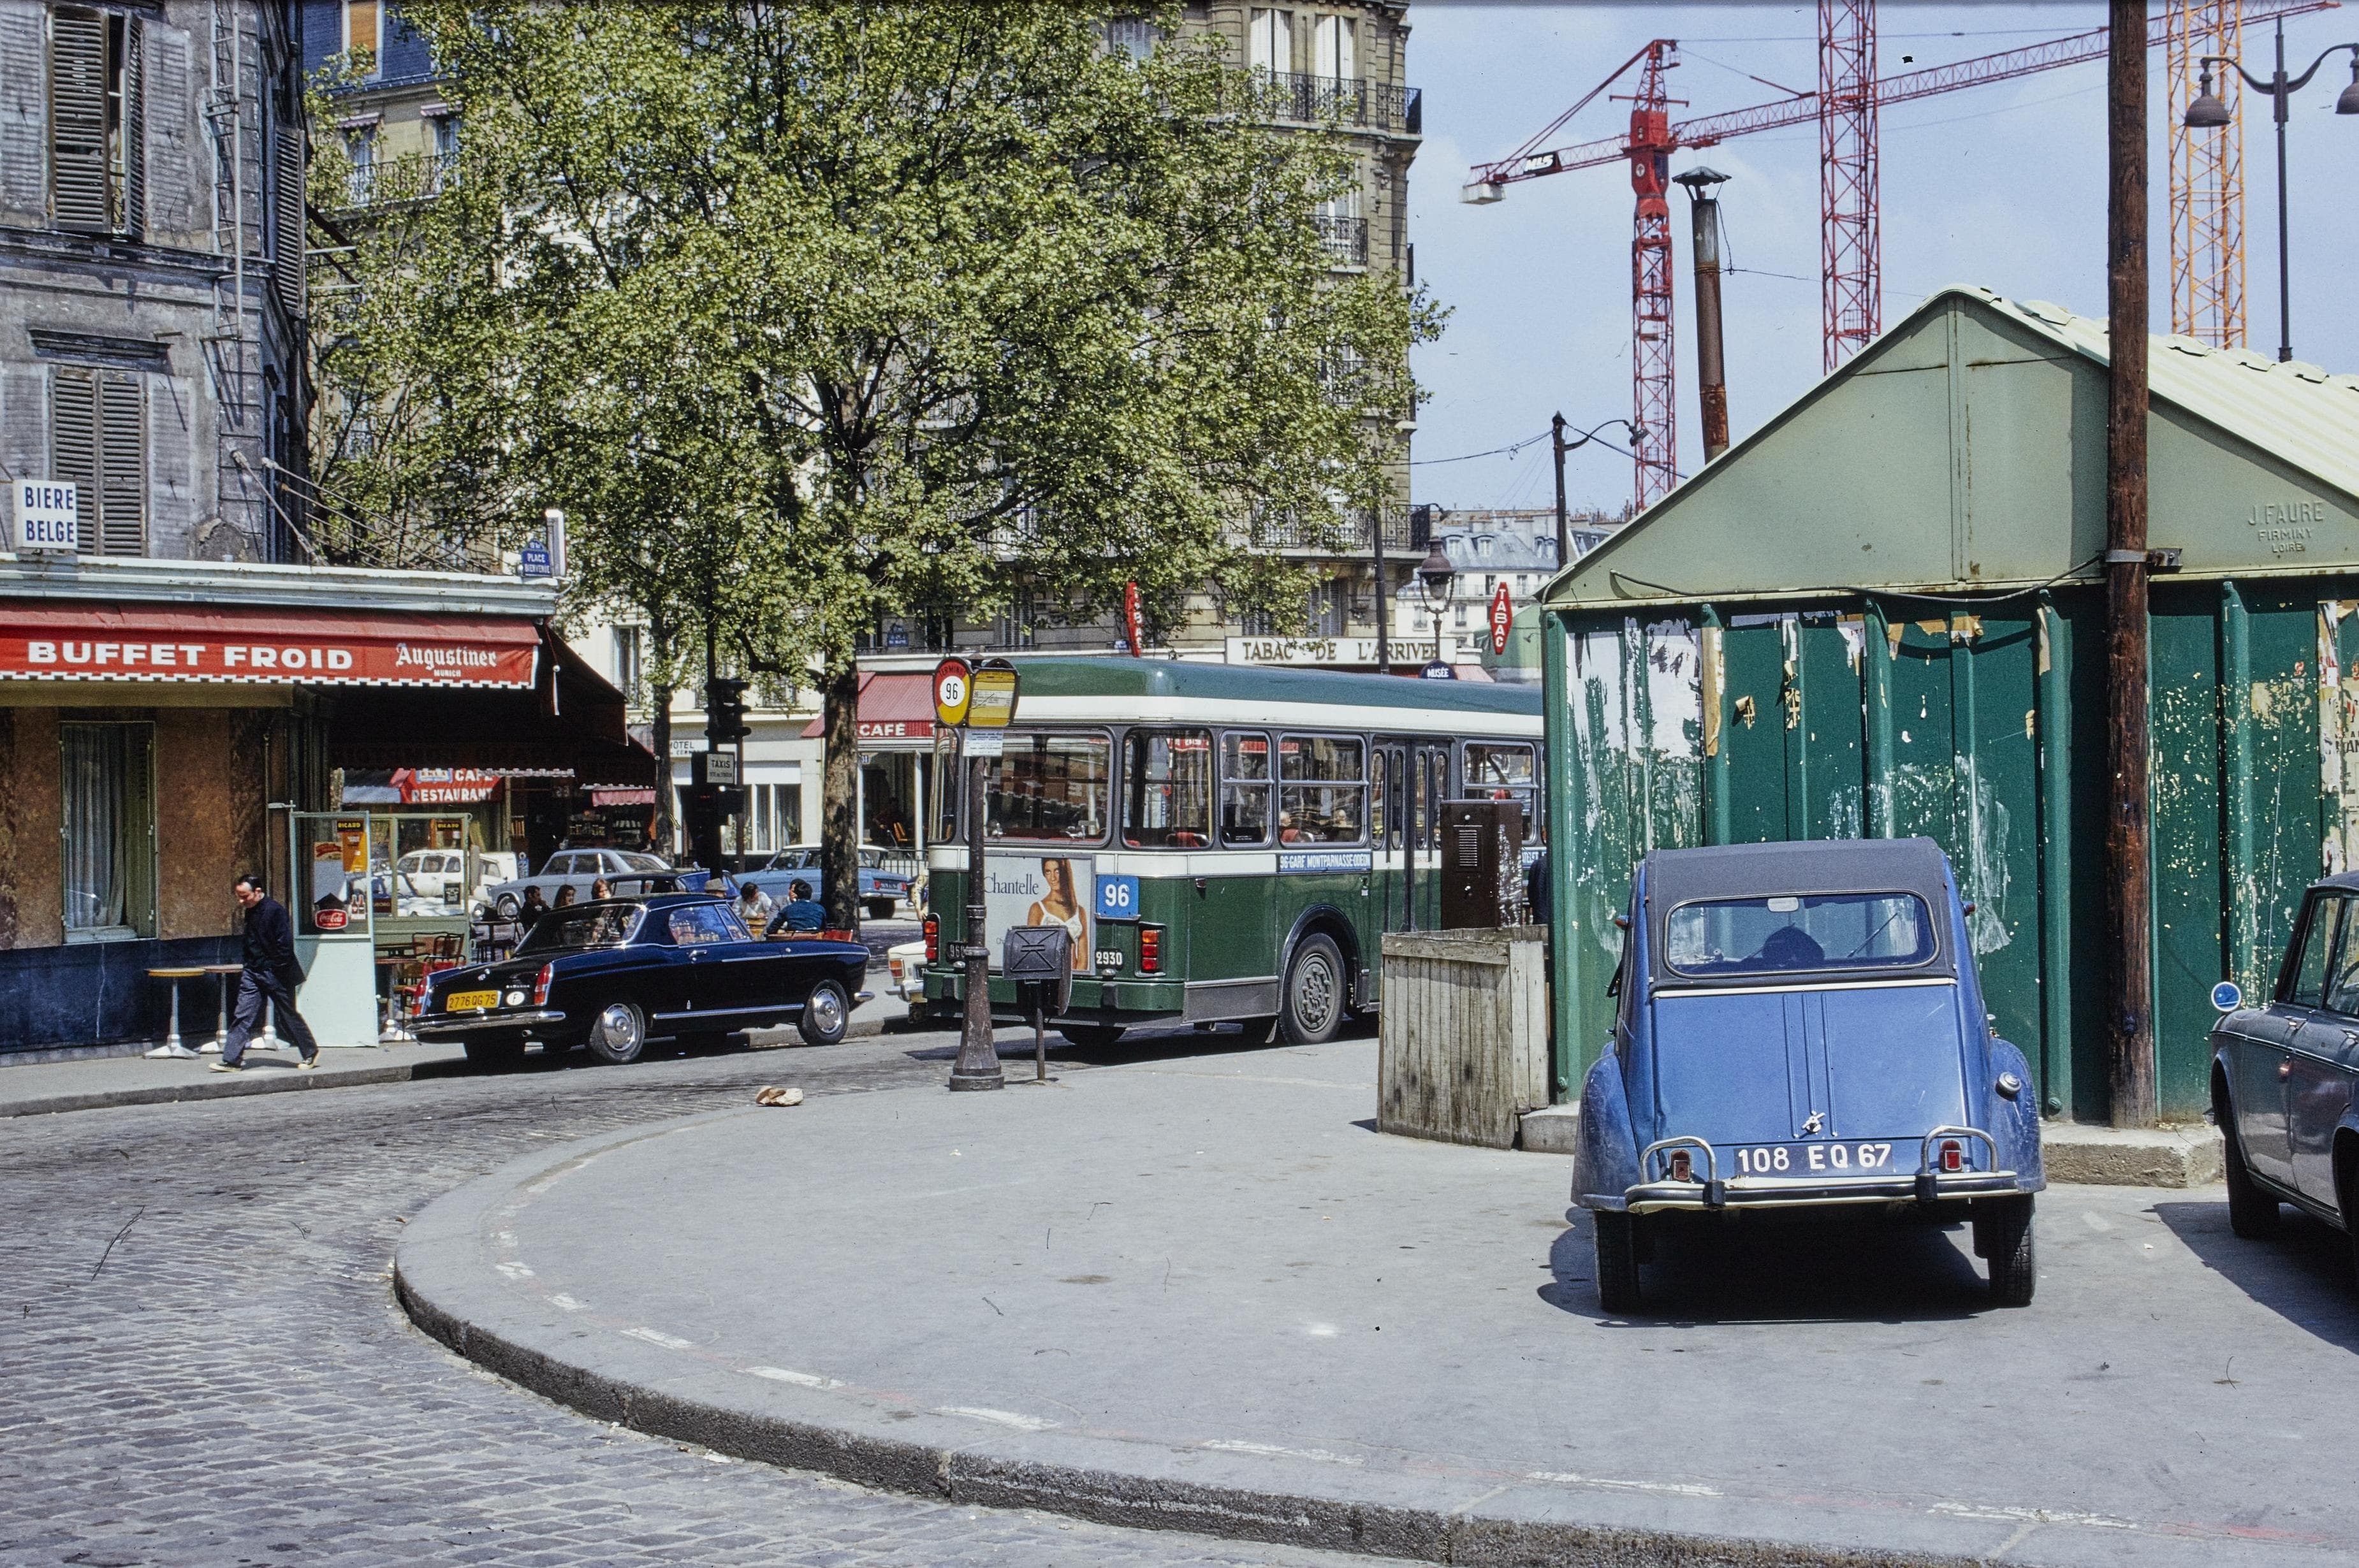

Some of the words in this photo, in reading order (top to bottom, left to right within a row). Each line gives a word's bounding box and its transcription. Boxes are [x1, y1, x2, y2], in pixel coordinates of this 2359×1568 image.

[25, 486, 73, 510] BIERE
[2265, 500, 2324, 525] FAURE
[26, 519, 75, 543] BELGE
[2258, 527, 2312, 542] FIRMINY
[2271, 541, 2304, 553] LOIRE
[527, 553, 546, 563] PLACE
[1494, 588, 1508, 648] TABAC
[27, 641, 206, 666] BUFFET
[224, 646, 353, 669] FROID
[395, 642, 497, 671] Augustiner
[1242, 641, 1293, 660] TABAC
[1315, 642, 1337, 660] DE
[434, 669, 462, 678] MUNICH
[1427, 667, 1449, 678] MUSÉE
[946, 683, 958, 700] 96
[712, 760, 731, 769] TAXIS
[411, 788, 493, 802] RESTAURANT
[984, 872, 1039, 895] Chantelle
[1105, 884, 1130, 907] 96
[1096, 951, 1123, 965] 2930
[449, 996, 470, 1008] 2776
[485, 994, 496, 1005] 75
[1738, 1147, 1790, 1172] 108
[1808, 1145, 1848, 1170] EQ
[1858, 1143, 1891, 1168] 67
